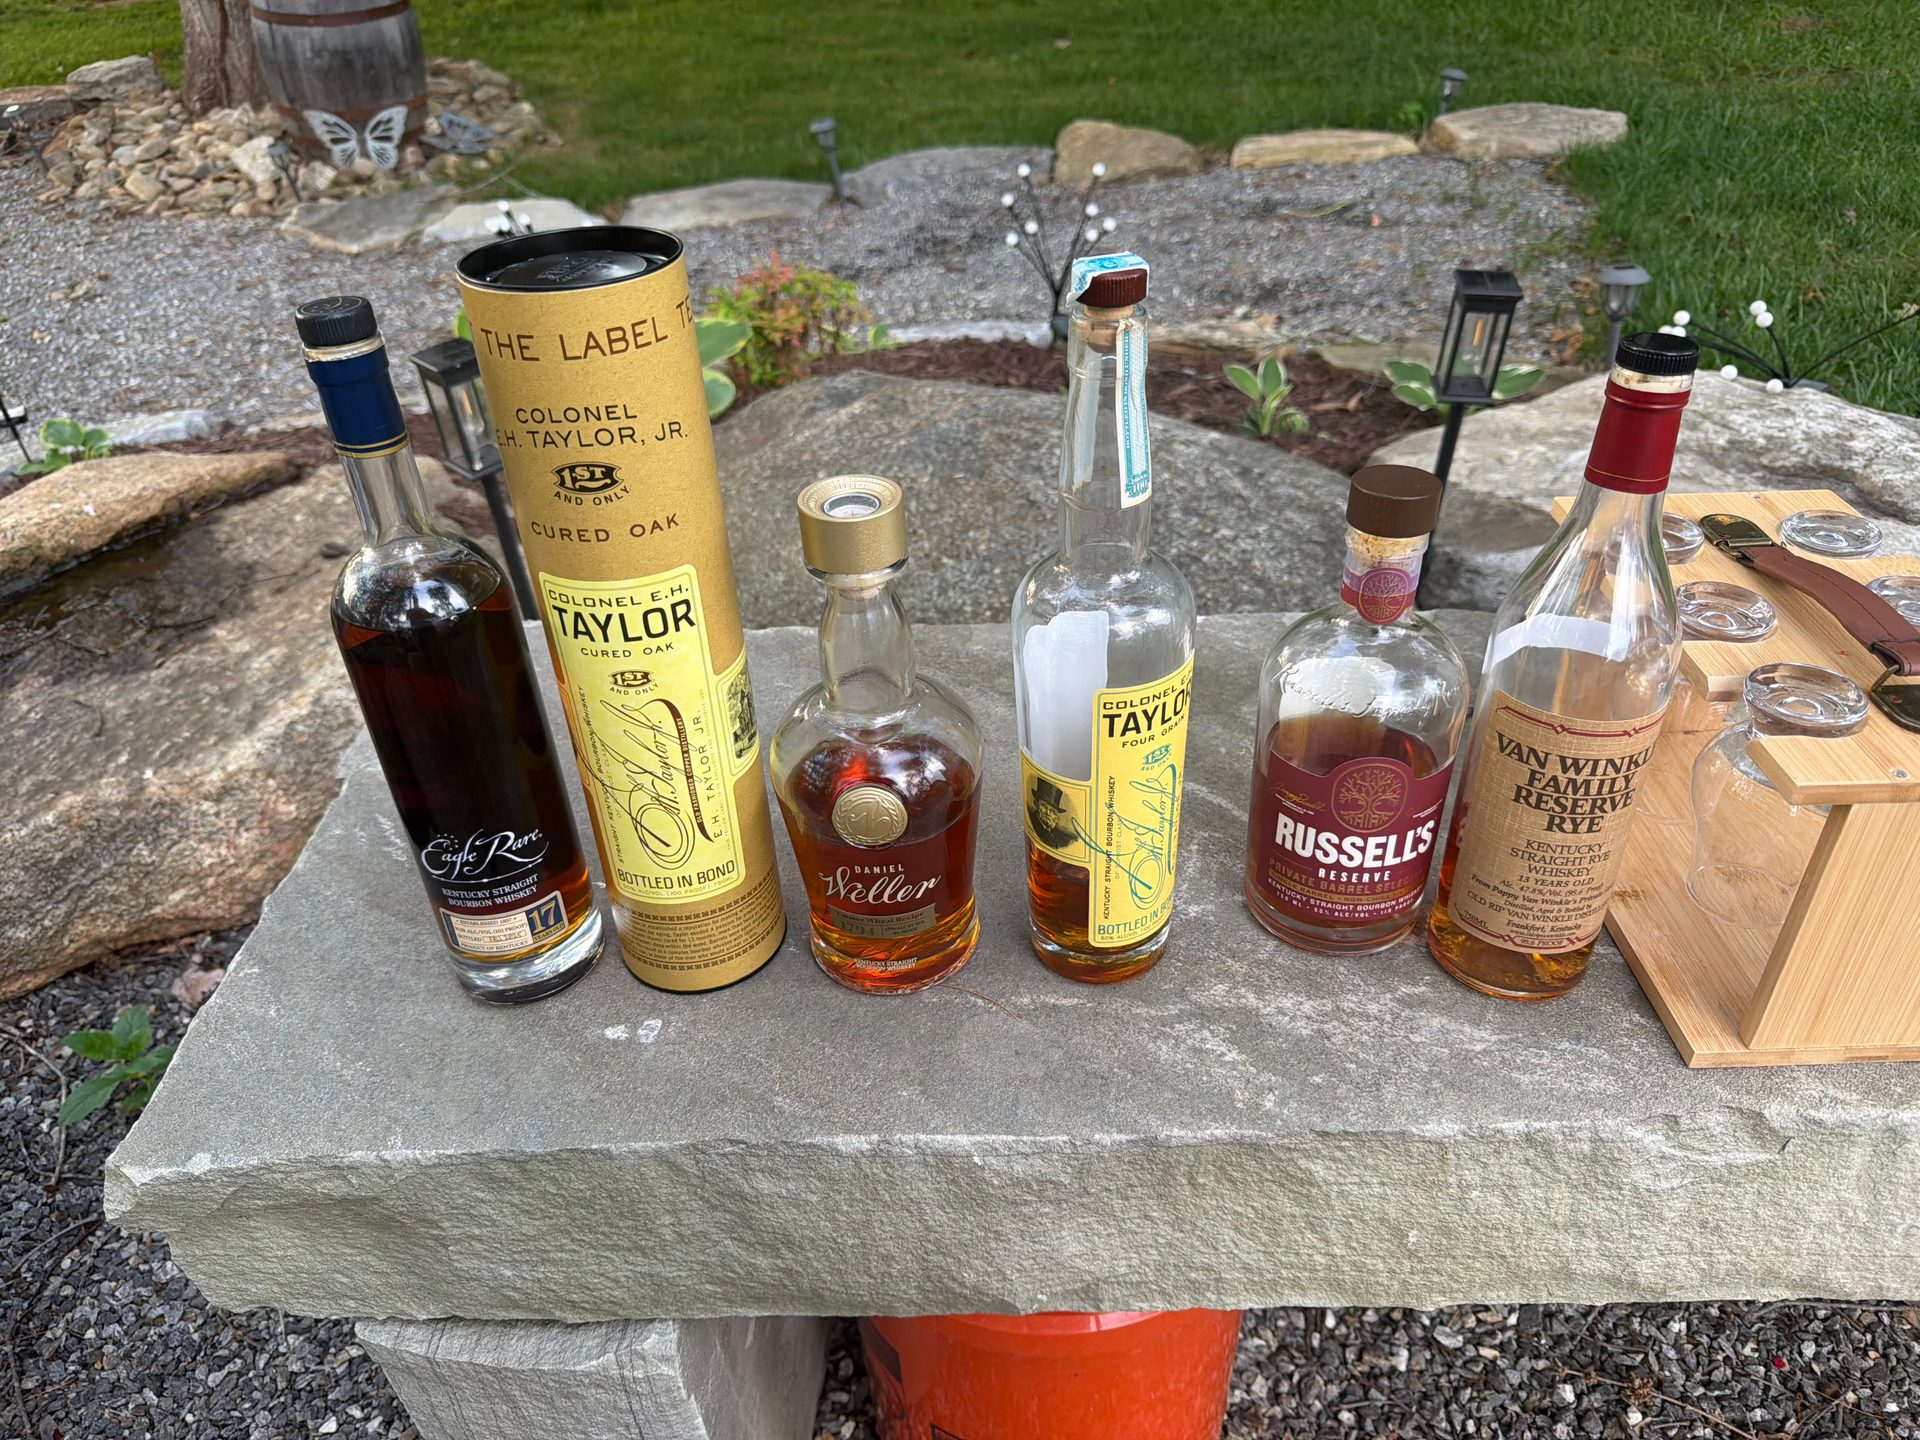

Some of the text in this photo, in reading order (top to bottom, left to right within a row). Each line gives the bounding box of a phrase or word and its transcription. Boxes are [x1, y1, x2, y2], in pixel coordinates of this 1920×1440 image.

[480, 327, 540, 362] THE
[559, 316, 668, 361] LABEL
[516, 404, 638, 424] COLONEL
[527, 426, 646, 449] TAYLOR,
[655, 421, 688, 441] JR.
[563, 465, 606, 488] 1ST
[553, 484, 631, 506] AND ONLY
[531, 513, 680, 542] CURED OAK
[548, 584, 689, 608] COLONEL E.H.
[552, 598, 696, 643] TAYLOR
[580, 642, 675, 658] CURED OAK
[610, 683, 659, 696] AND ONLY
[1103, 685, 1177, 710] COLONEL
[1122, 713, 1184, 748] FOUR GRAIN
[1496, 730, 1656, 776] VAN WINKL
[698, 744, 715, 801] TAYLOR
[1525, 768, 1637, 797] FAMILY
[1107, 775, 1116, 810] WHISKEY
[1510, 784, 1636, 815] RESERVE
[1106, 811, 1114, 847] BOURBON
[1543, 814, 1604, 834] RYE
[610, 824, 624, 864] STRAIGHT
[1274, 811, 1435, 868] RUSSELL'S
[1524, 839, 1605, 855] KENTUCKY
[421, 829, 483, 879] Eagle
[1510, 847, 1611, 867] STRAIGHT RYE
[617, 860, 735, 889] BOTTLED IN BOND
[854, 863, 904, 874] DANIEL
[1269, 856, 1315, 886] PRIVATE
[1320, 879, 1370, 894] BARREL
[1318, 868, 1391, 883] RESERVE
[1518, 875, 1530, 883] 13
[1533, 878, 1570, 888] YEARS
[1572, 877, 1595, 887] OLD
[1526, 863, 1594, 878] WHISKEY
[442, 874, 538, 899] KENTUCKY STRAIGHT
[448, 884, 538, 908] BOURBON WHISKEY
[818, 866, 941, 905] Weller
[1268, 878, 1307, 901] KENTUCKY
[1309, 898, 1354, 911] STRAIGHT
[1357, 900, 1396, 911] BOURBON
[1300, 886, 1334, 900] BARREL
[1471, 874, 1491, 890] From
[1492, 885, 1520, 901] Pappy
[1522, 895, 1538, 904] Van
[1103, 886, 1111, 920] KENTUCKY
[1292, 899, 1302, 907] ML
[1467, 890, 1487, 906] OLD
[1488, 902, 1506, 913] RIP
[1507, 909, 1531, 920] VAN
[1537, 907, 1555, 915] Aged
[529, 902, 556, 933] 17
[1098, 907, 1159, 936] BOTTLED IN
[1506, 919, 1582, 933] Frankfort, Kentucky
[496, 940, 529, 950] KENTUCKY
[887, 957, 917, 966] STRAIGHT
